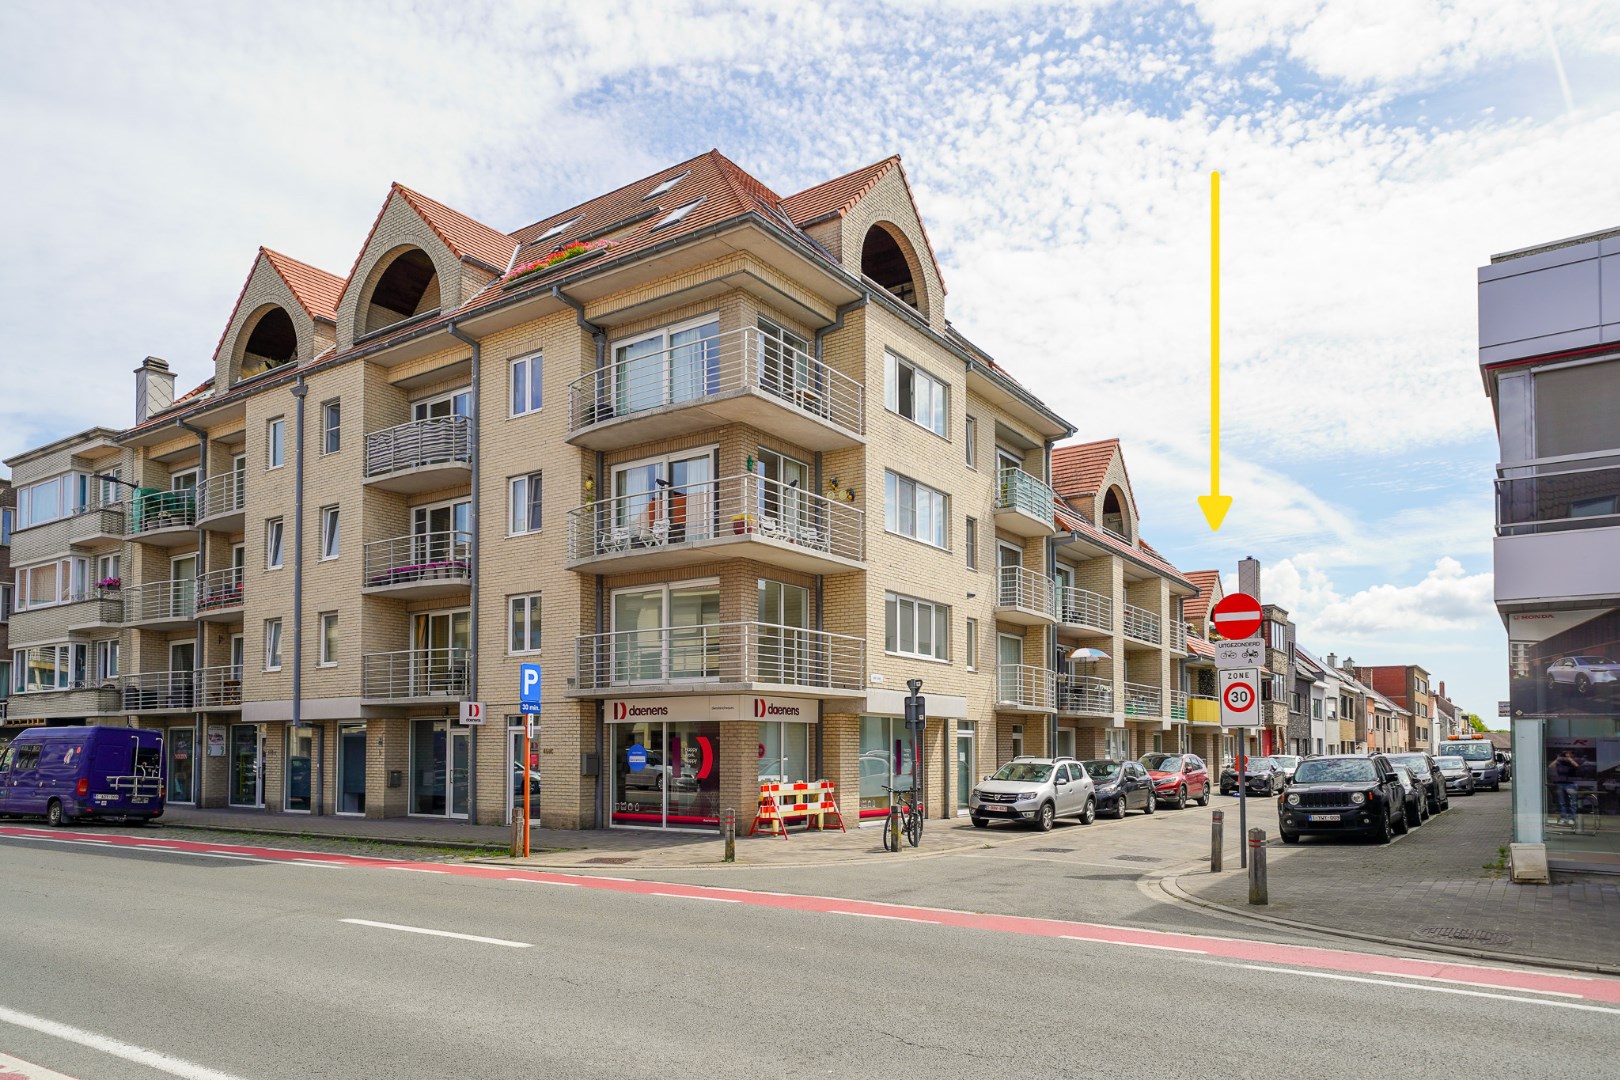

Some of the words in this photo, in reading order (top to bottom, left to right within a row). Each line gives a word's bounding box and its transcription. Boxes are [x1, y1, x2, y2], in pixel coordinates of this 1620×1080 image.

[1218, 641, 1261, 649] UITGEZONDERD
[523, 669, 539, 695] P
[1227, 672, 1250, 680] ZONE
[1231, 691, 1248, 703] 30
[628, 704, 669, 716] daenens
[767, 703, 800, 716] daenens
